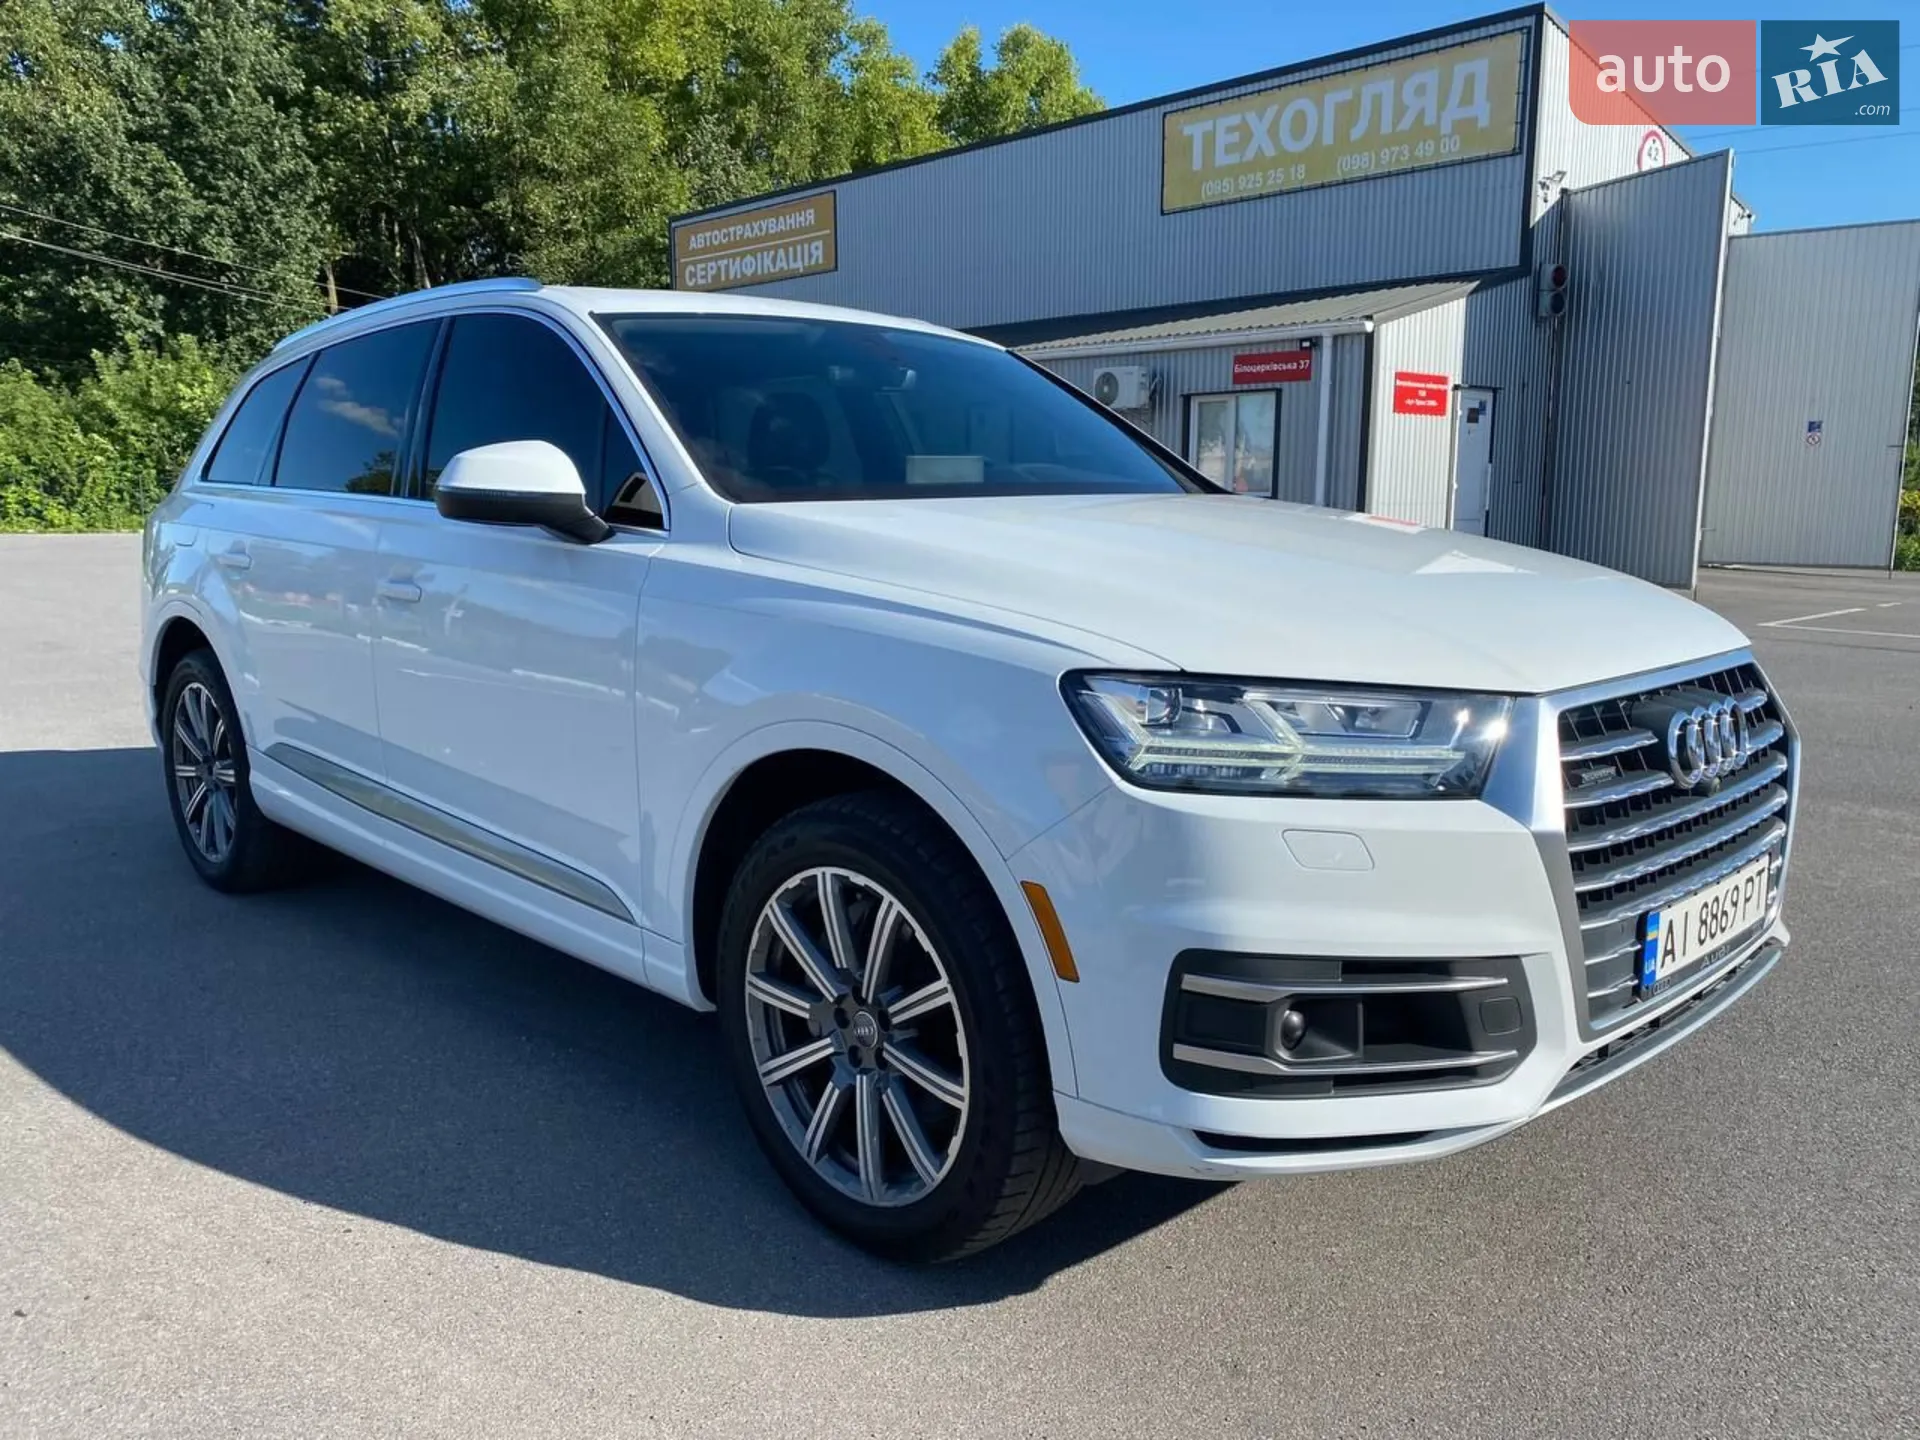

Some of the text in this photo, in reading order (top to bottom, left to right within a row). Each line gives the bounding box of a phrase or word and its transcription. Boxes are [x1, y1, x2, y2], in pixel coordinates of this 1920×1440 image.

[1183, 58, 1491, 172] ТЕХОГЛЯД
[1380, 143, 1411, 166] 973
[1414, 138, 1436, 158] 49
[1439, 133, 1461, 154] 00
[1238, 172, 1264, 191] 925
[1266, 167, 1285, 185] 25
[1289, 163, 1306, 181] 18
[688, 208, 816, 251] АВТОСТРАХУВАННЯ
[684, 240, 824, 287] СЕРТИФІКАЦІЯ
[1299, 359, 1311, 371] 37
[1660, 867, 1766, 970] AI 8869 PT
